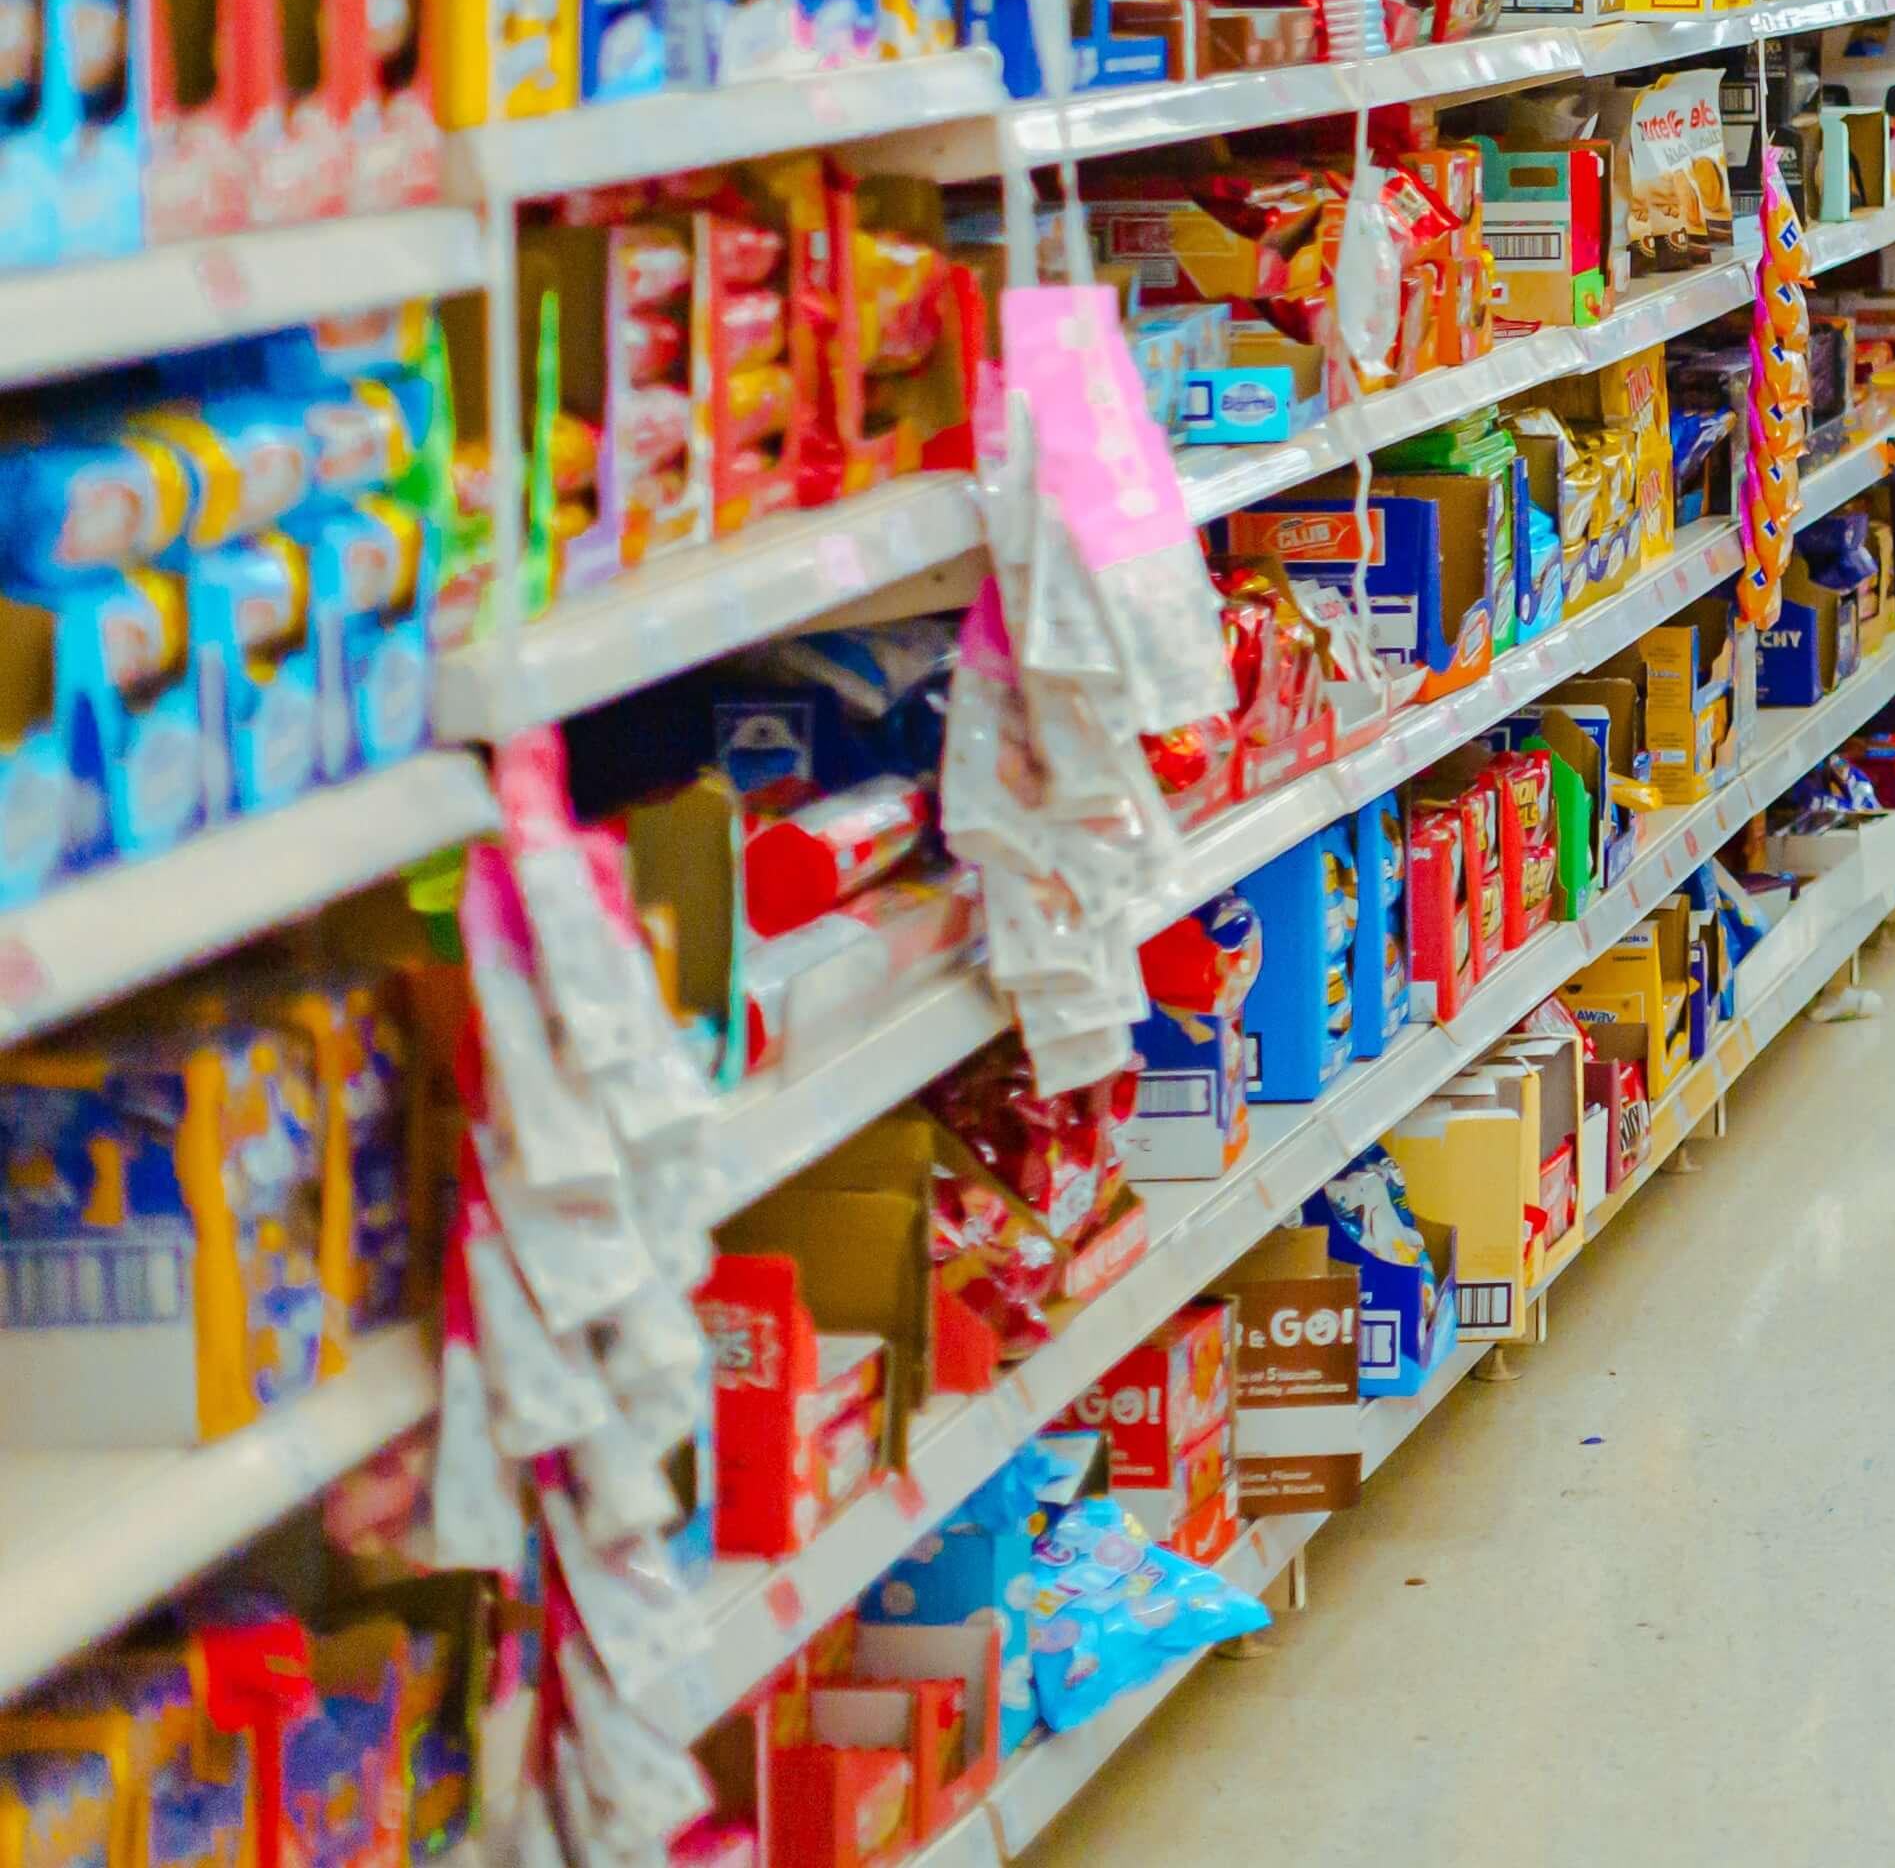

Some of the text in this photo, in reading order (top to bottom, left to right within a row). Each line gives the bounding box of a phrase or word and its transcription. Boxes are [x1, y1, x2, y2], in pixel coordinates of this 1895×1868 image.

[1276, 523, 1330, 550] CLUB
[1758, 630, 1803, 649] CHY
[1269, 1308, 1355, 1348] GO!
